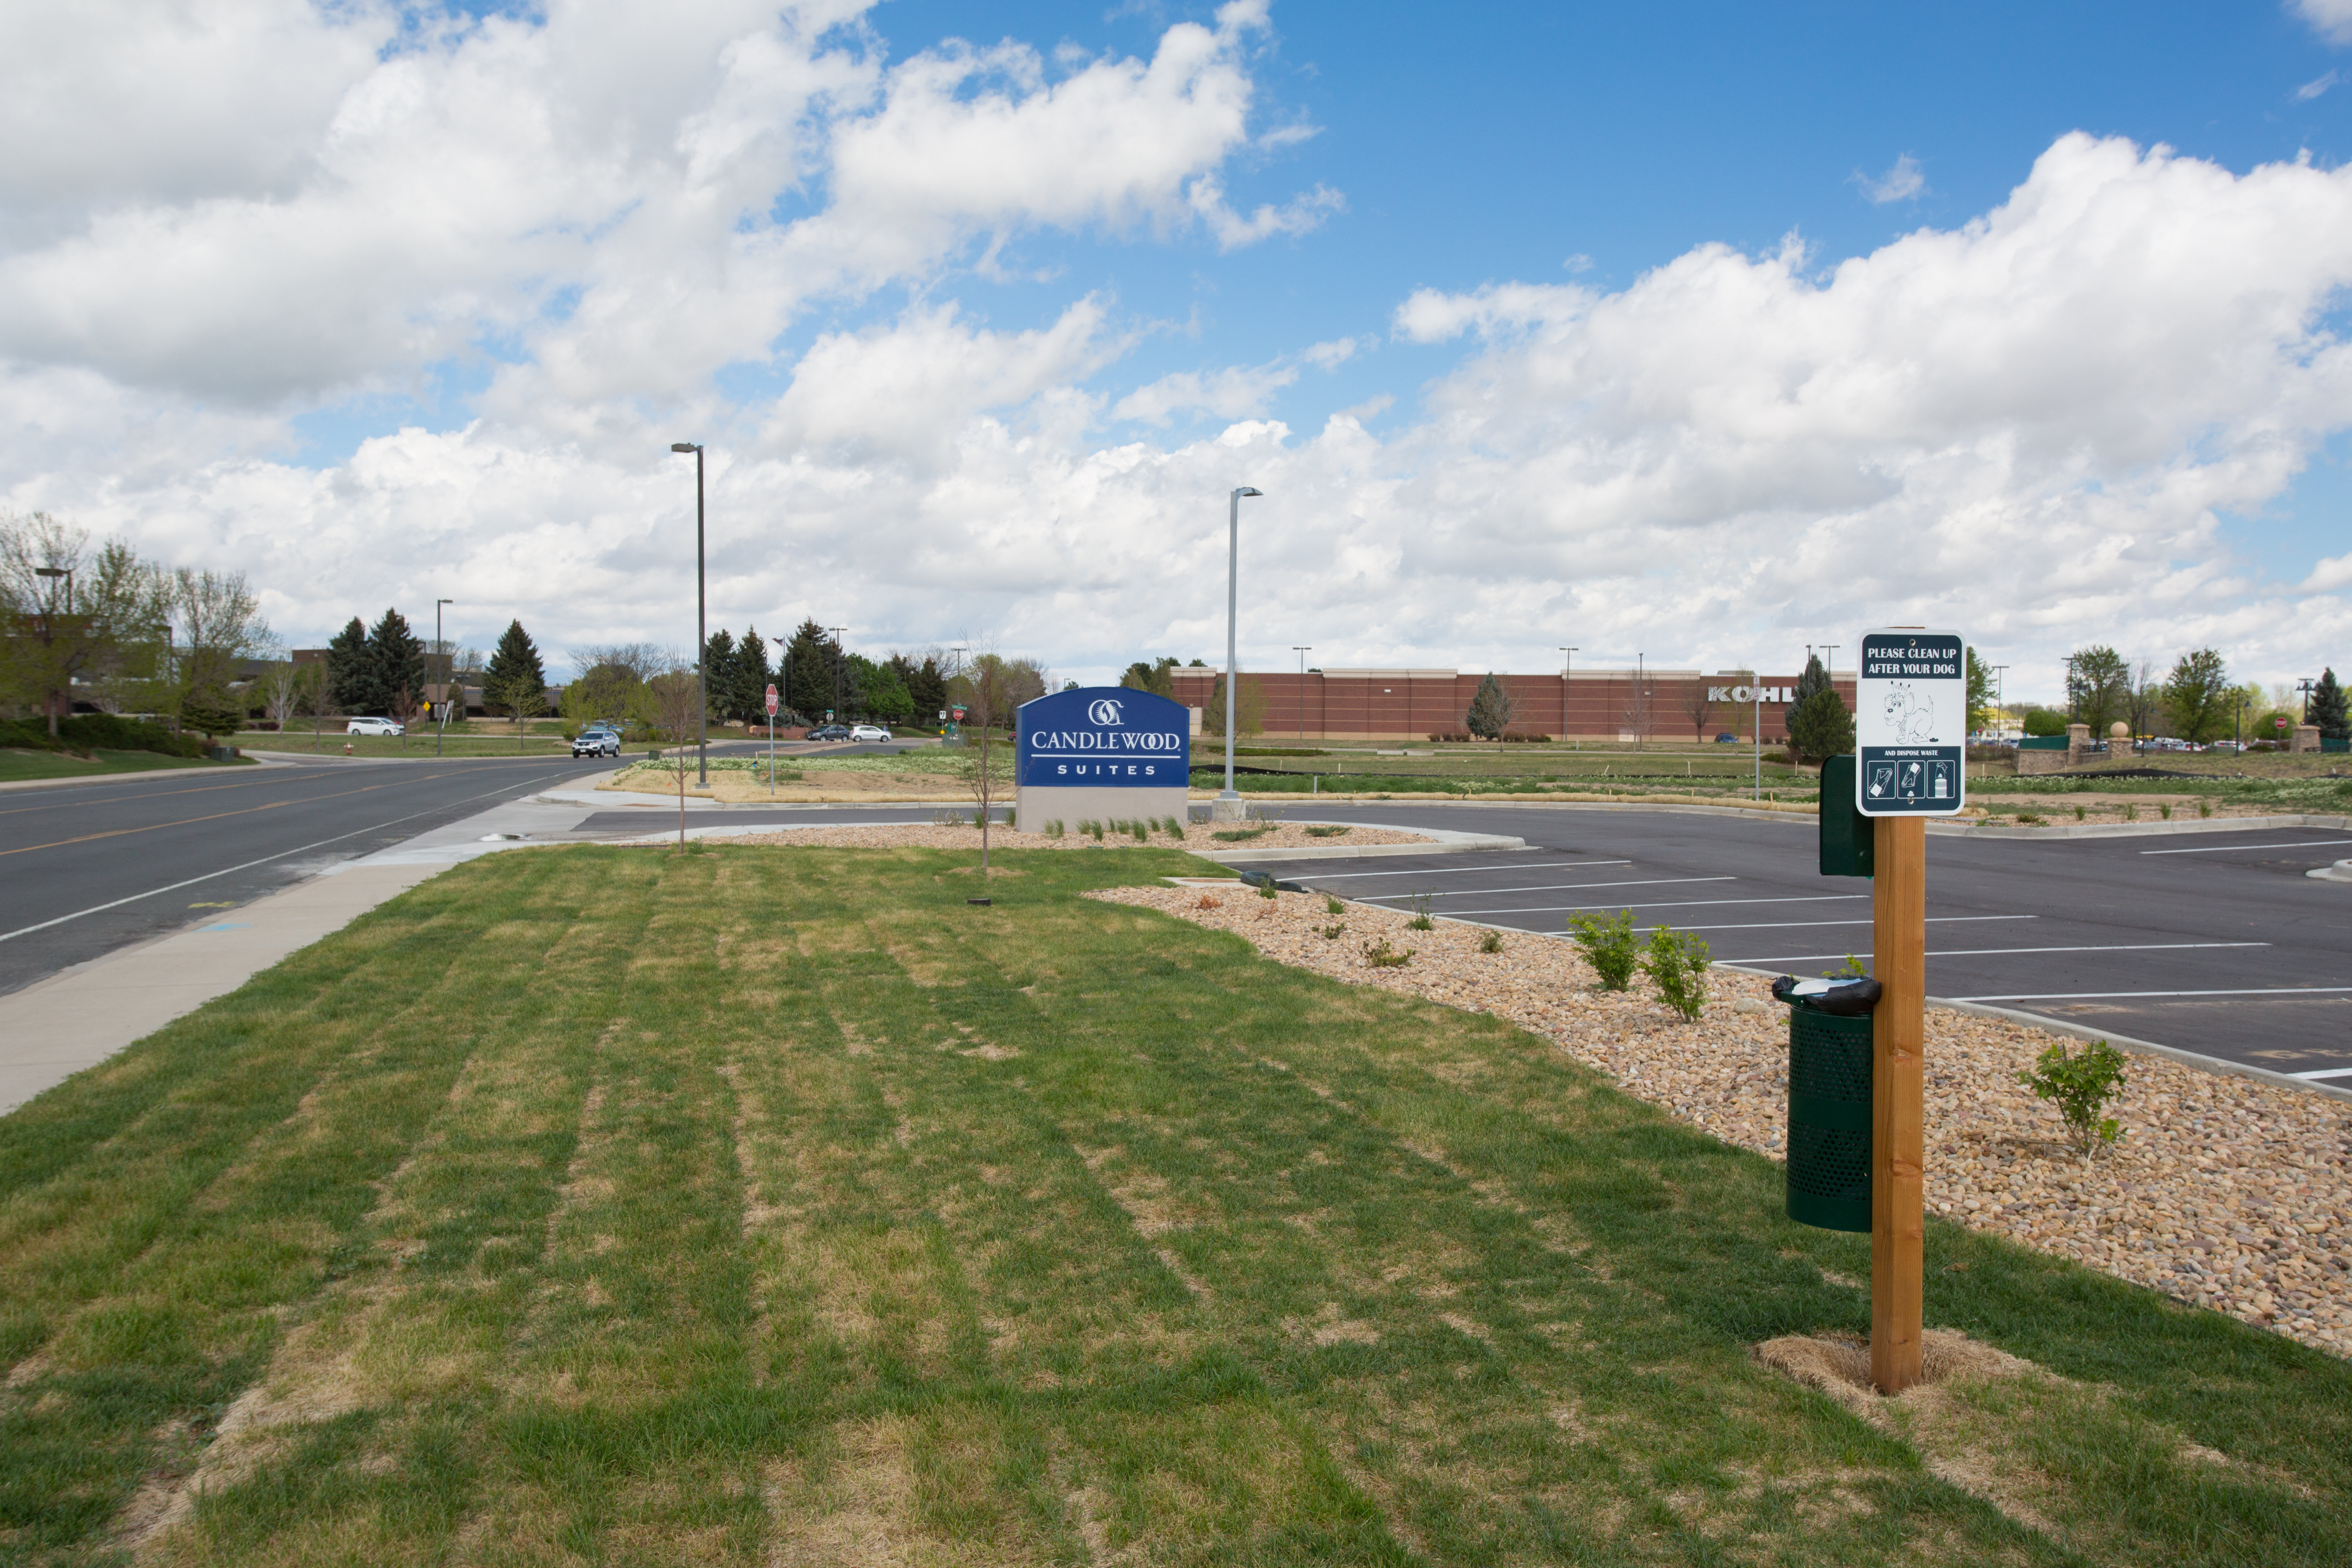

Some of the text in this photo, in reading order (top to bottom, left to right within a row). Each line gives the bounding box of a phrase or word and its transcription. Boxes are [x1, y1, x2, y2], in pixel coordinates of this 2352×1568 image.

[1868, 648, 1956, 659] PLEASE CLEAN UP
[1868, 664, 1955, 674] AFTER YOUR DOG
[767, 695, 777, 706] STOP
[1032, 731, 1180, 750] CANDLEWOOD
[1058, 765, 1155, 775] SUITES
